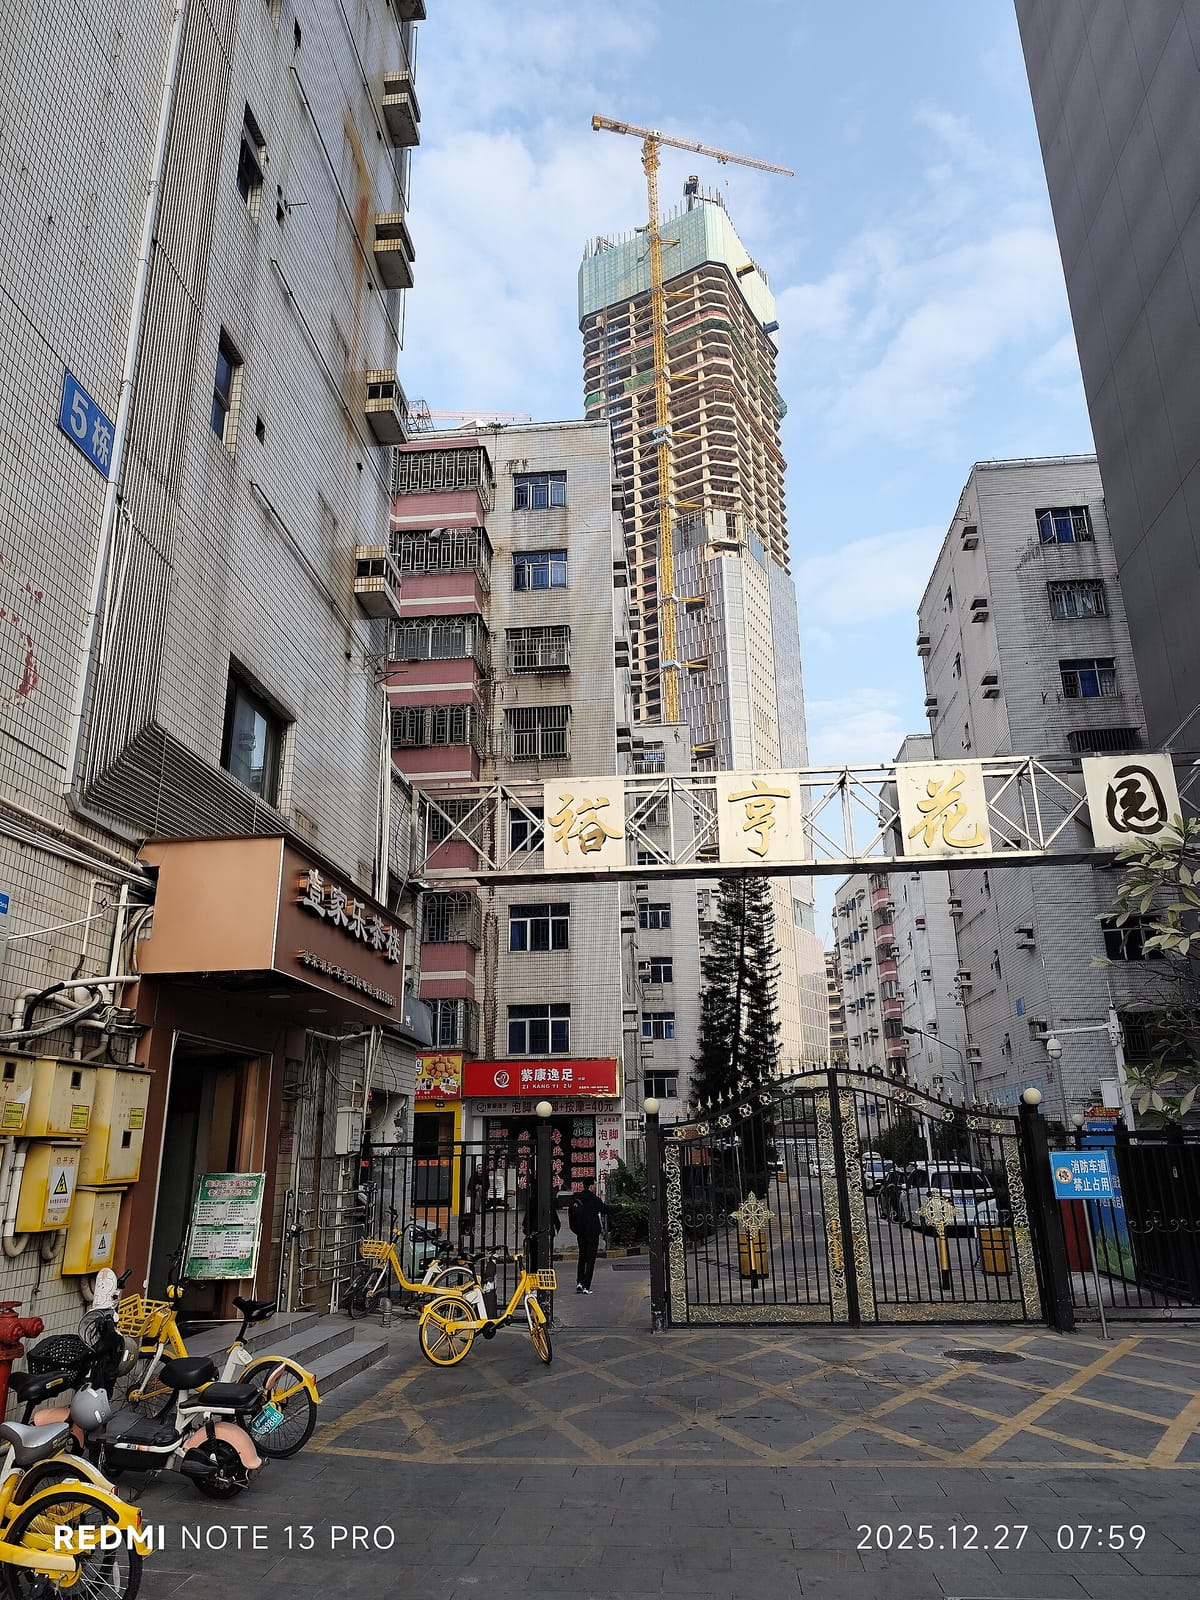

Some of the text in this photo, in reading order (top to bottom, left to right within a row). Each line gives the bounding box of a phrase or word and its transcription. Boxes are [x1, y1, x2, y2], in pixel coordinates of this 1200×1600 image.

[70, 389, 111, 466] 5栋
[548, 764, 1167, 857] 裕亨花园
[303, 868, 401, 964] 壹家乐茶楼
[521, 1068, 573, 1082] 紫康逸足
[598, 1128, 619, 1141] 泡脚
[1070, 1159, 1107, 1174] 消防车道
[1072, 1177, 1110, 1192] 禁止占用
